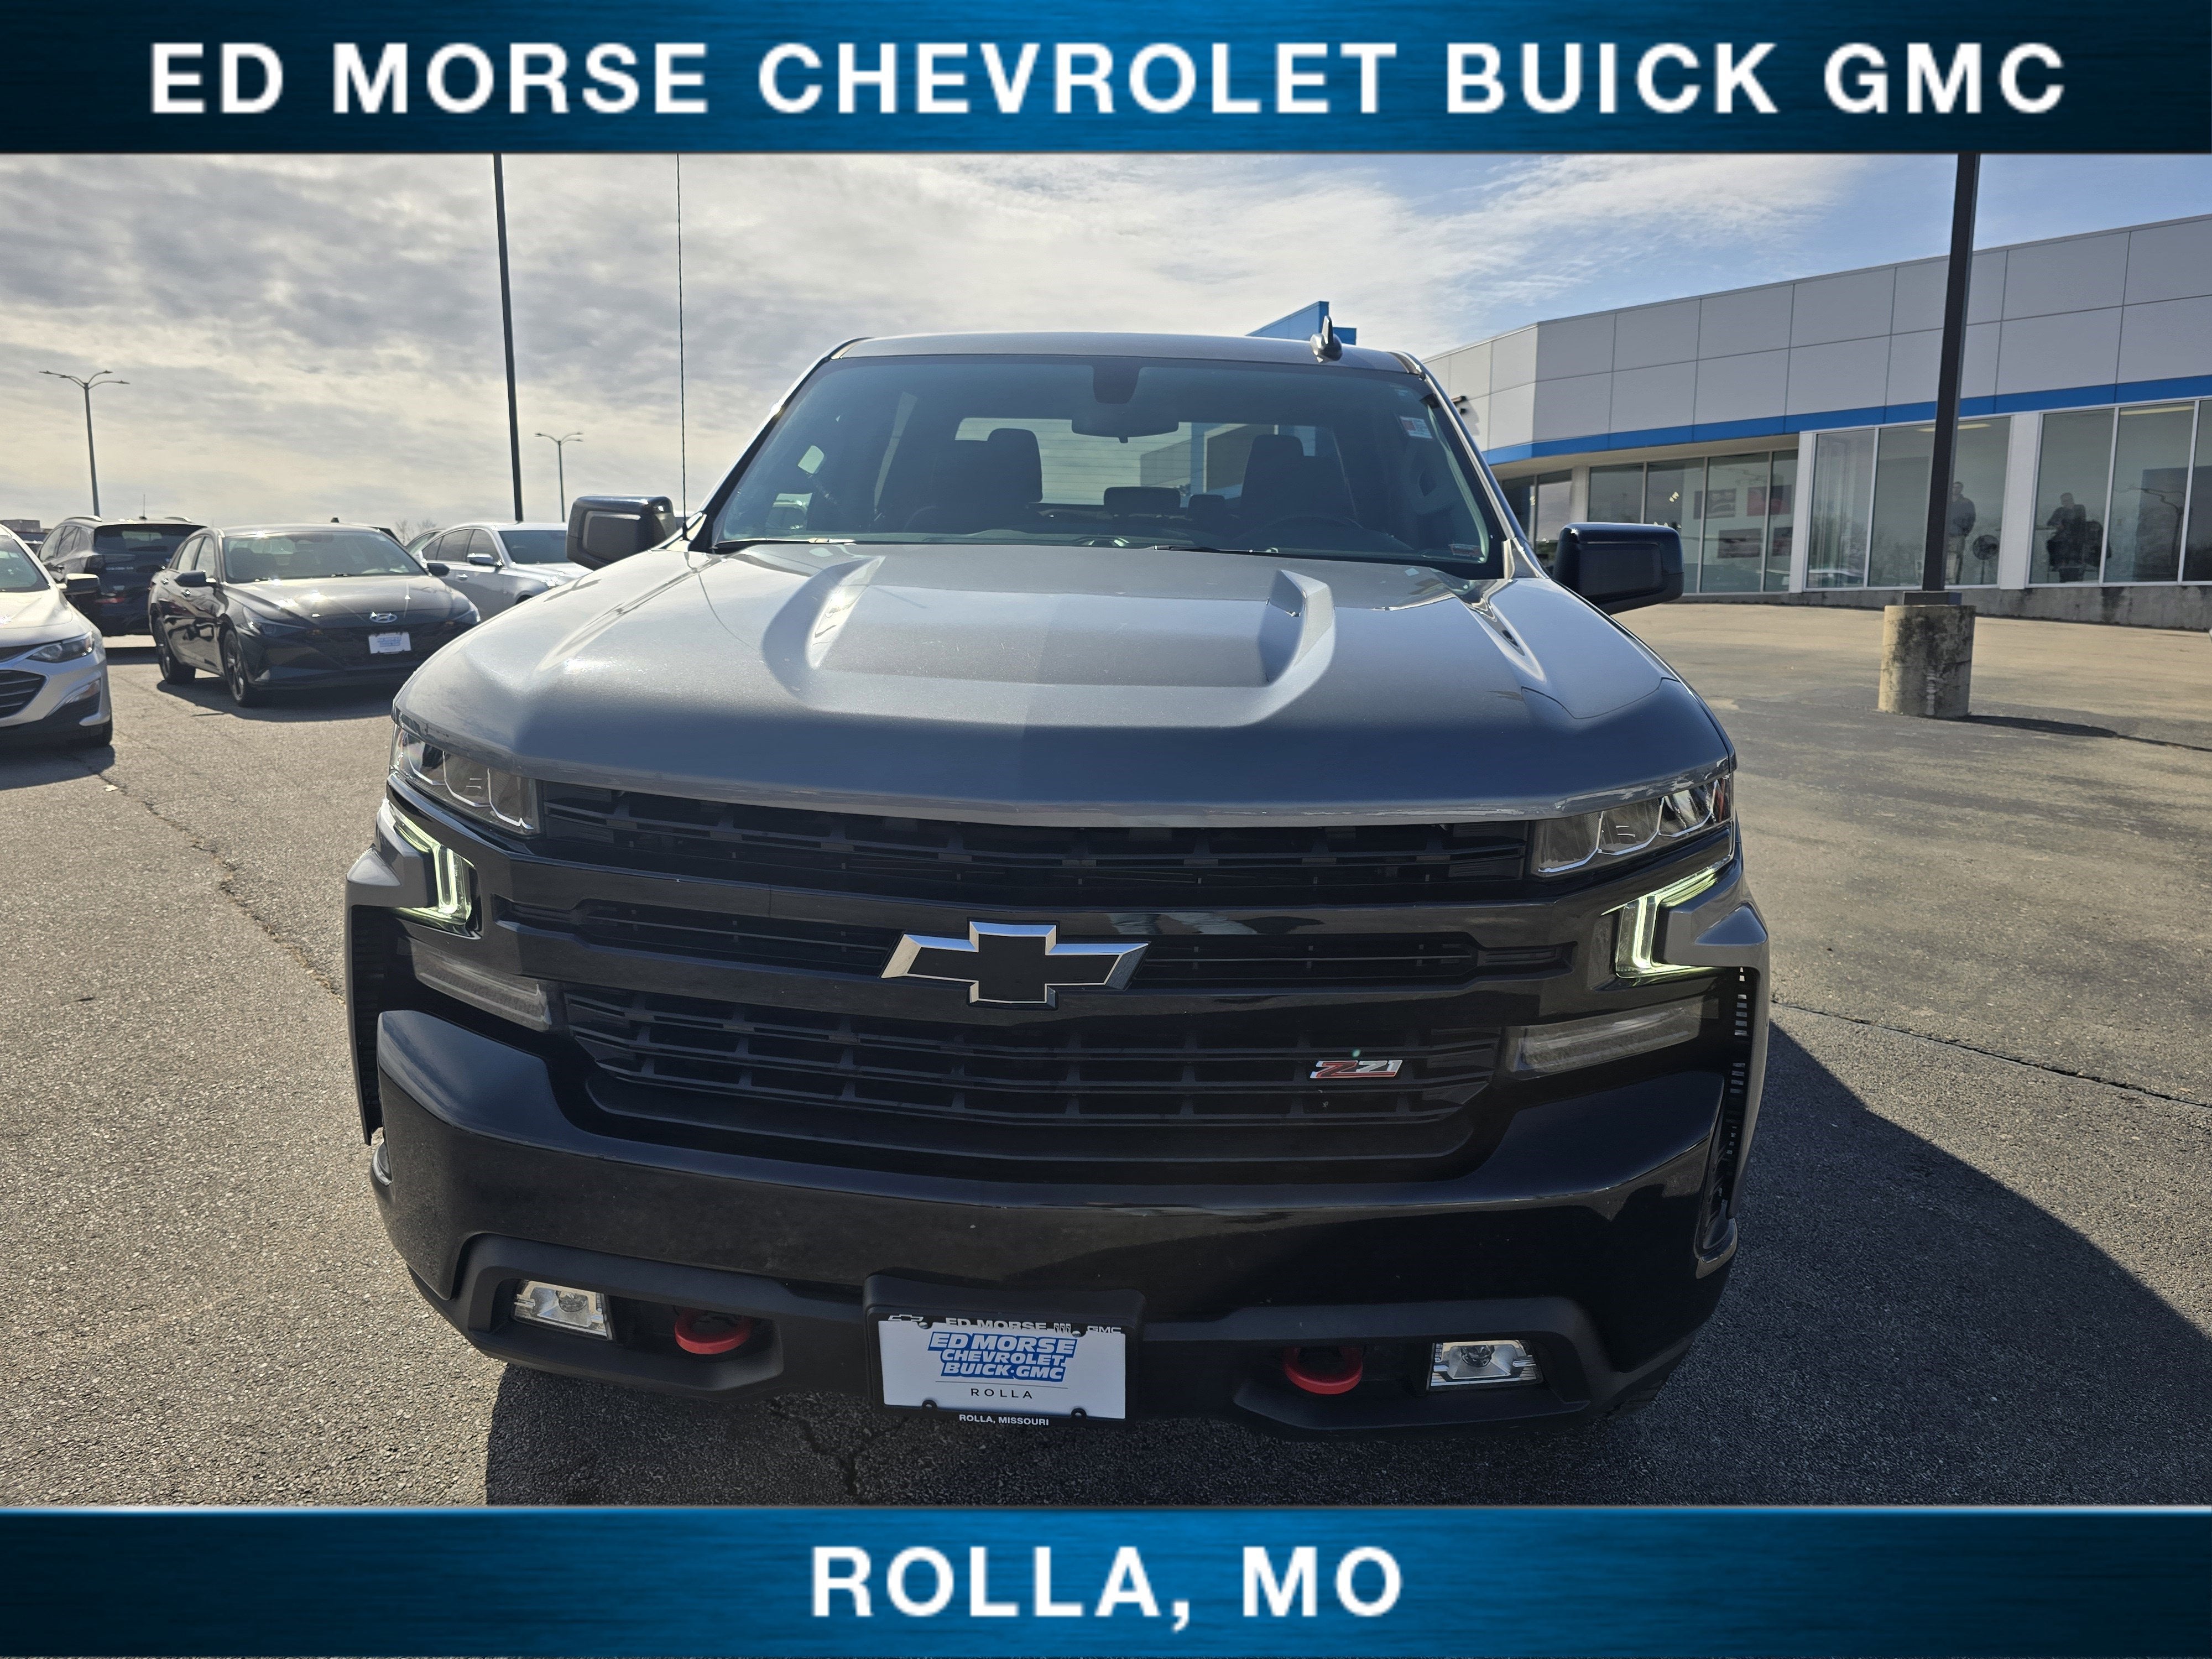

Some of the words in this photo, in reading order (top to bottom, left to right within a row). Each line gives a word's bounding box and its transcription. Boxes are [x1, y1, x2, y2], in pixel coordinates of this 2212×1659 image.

[945, 1317, 971, 1327] ED
[977, 1319, 1047, 1331] MORSE
[1087, 1326, 1121, 1334] GMC
[930, 1333, 968, 1348] ED
[971, 1334, 1076, 1354] MORSE
[941, 1349, 1065, 1366] CHEVROLET
[971, 1388, 1033, 1399] ROLLA
[959, 1414, 996, 1424] ROLLA,
[998, 1416, 1049, 1426] MISSOURI
